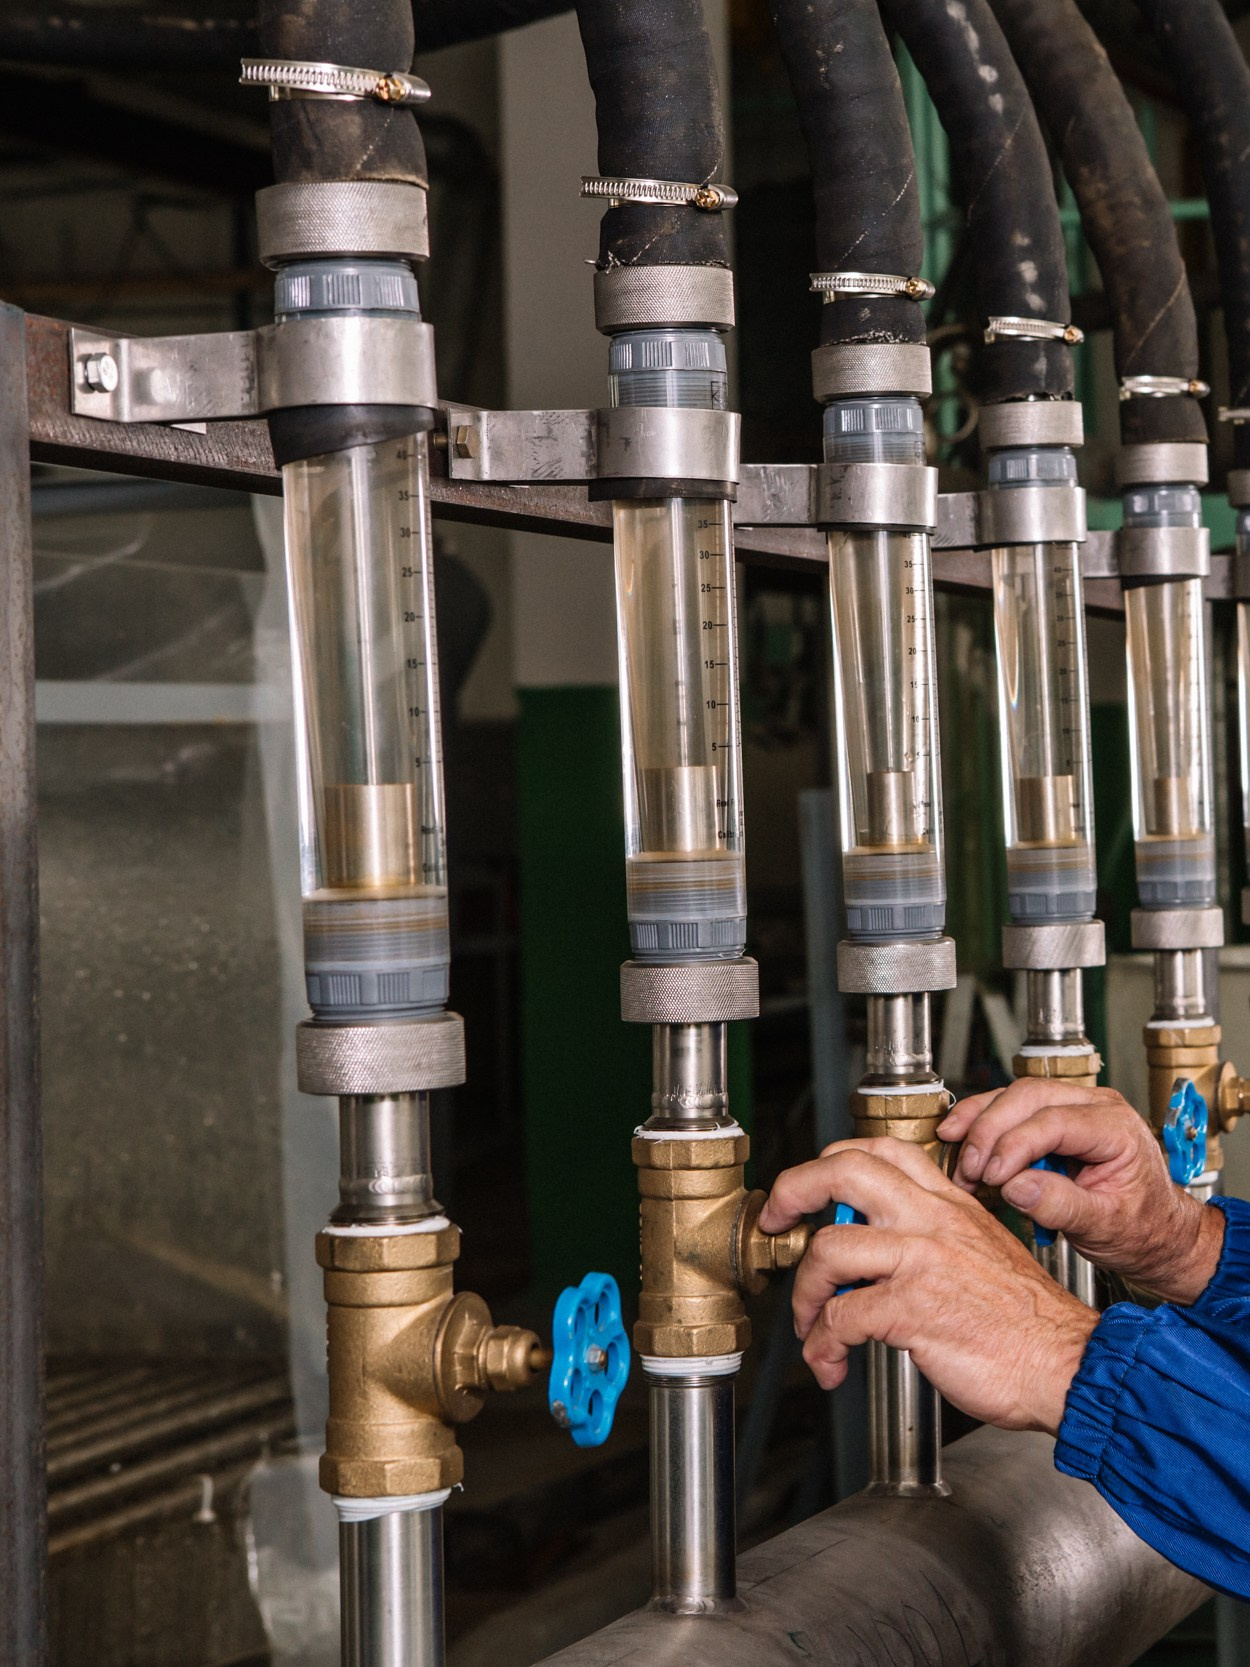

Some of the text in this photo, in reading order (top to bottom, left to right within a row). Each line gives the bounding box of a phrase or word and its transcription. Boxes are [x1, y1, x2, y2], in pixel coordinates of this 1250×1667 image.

[398, 491, 410, 501] 35
[698, 520, 709, 529] 35
[400, 527, 411, 537] 30
[699, 551, 709, 559] 30
[904, 560, 913, 568] 35
[402, 567, 413, 578] 25
[701, 584, 711, 592] 25
[404, 612, 416, 622] 20
[906, 615, 915, 623] 25
[702, 621, 713, 629] 20
[908, 647, 917, 655] 20
[407, 659, 418, 669] 15
[704, 660, 714, 669] 15
[706, 700, 716, 709] 10
[409, 707, 420, 717] 10
[711, 742, 717, 751] 5
[415, 757, 421, 767] 5
